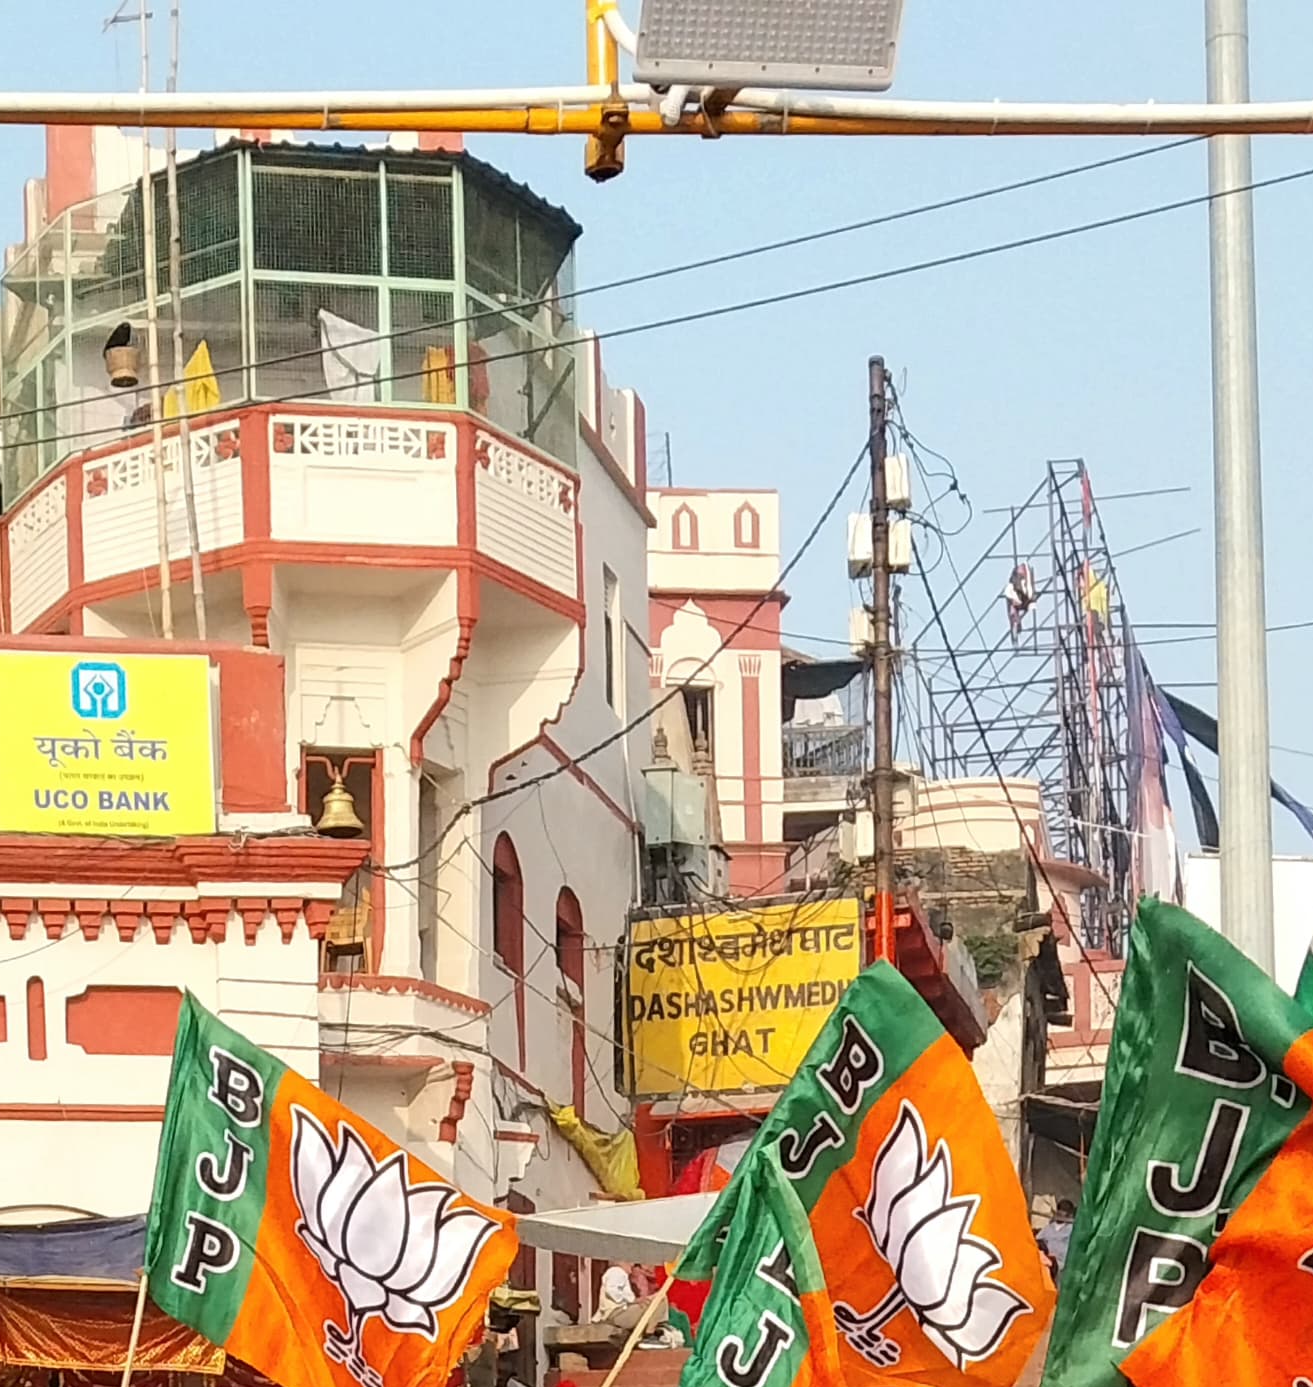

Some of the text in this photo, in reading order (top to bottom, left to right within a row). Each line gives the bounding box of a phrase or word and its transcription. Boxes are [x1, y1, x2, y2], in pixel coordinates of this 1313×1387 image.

[33, 729, 168, 768] यूको बैंक
[34, 788, 170, 811] UCO BANK
[688, 1027, 776, 1057] GHAT
